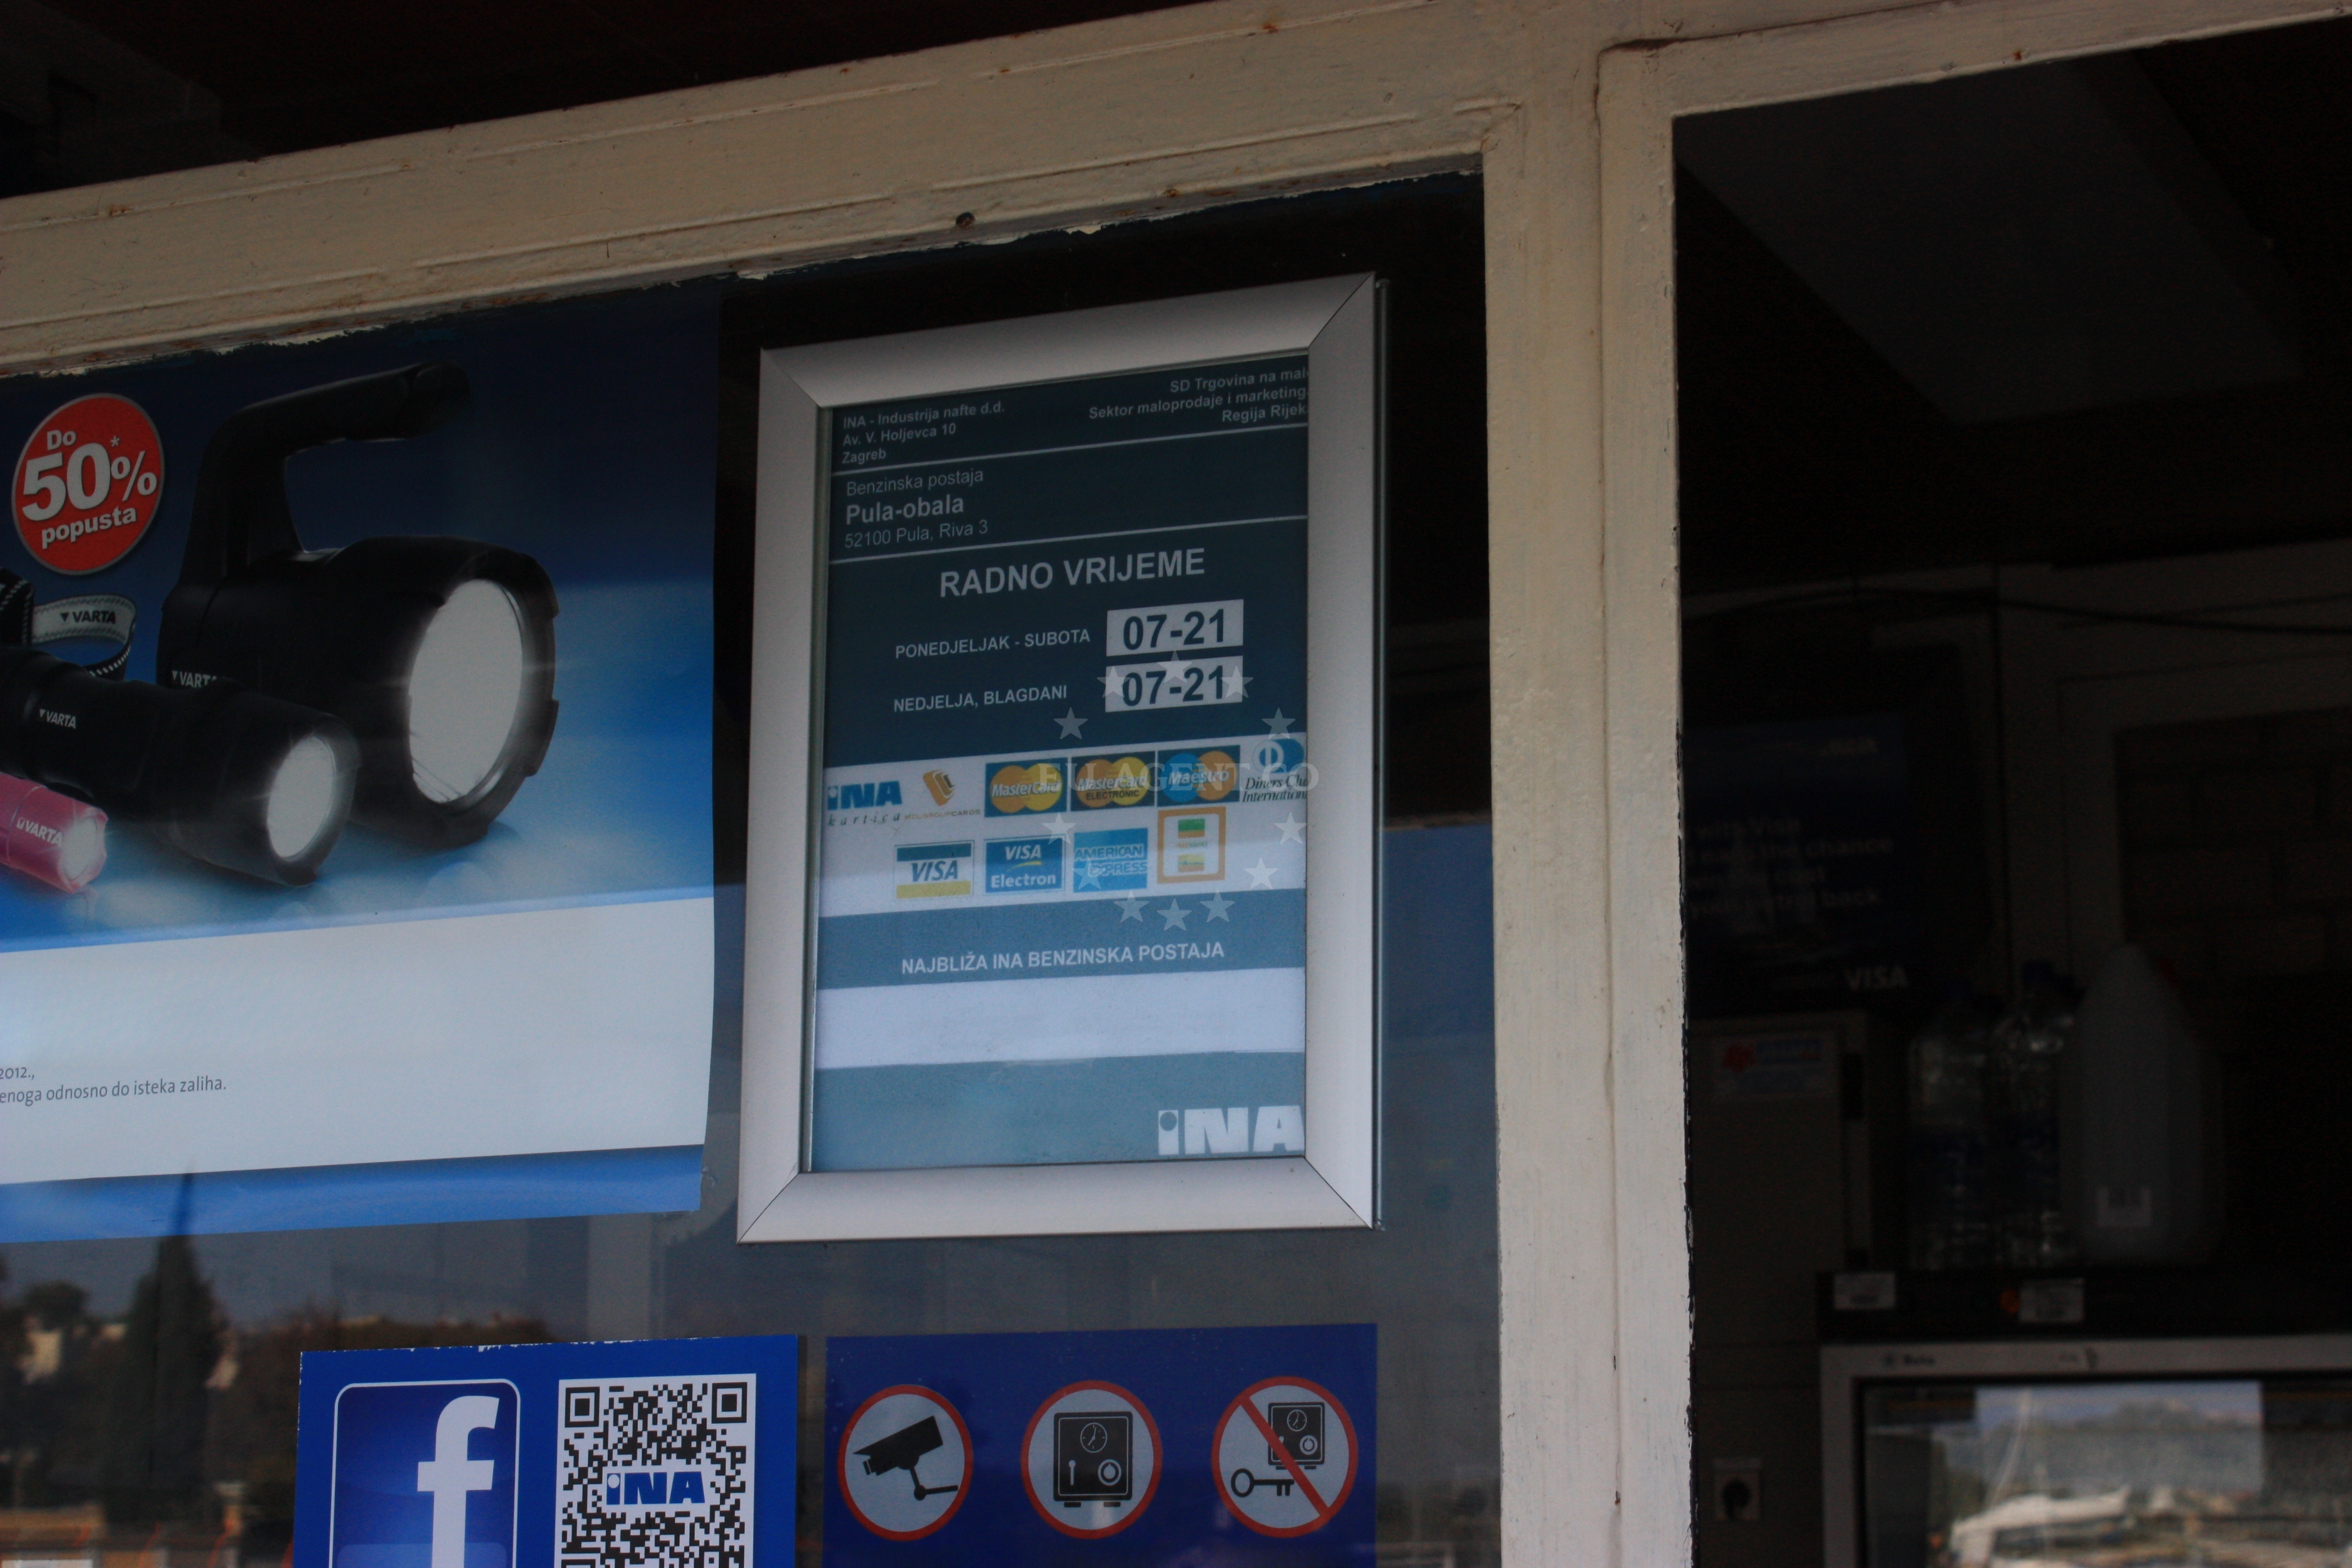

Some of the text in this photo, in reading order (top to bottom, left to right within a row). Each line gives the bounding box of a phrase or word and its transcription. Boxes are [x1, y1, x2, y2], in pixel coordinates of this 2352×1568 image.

[1169, 379, 1190, 393] SD
[1194, 374, 1255, 392] Trgovina
[1259, 371, 1276, 384] na
[1088, 386, 1308, 420] Sektor maloprodaje i marketing
[1222, 402, 1308, 424] Regija Rijek
[843, 415, 867, 429] INA
[878, 409, 939, 425] Industrija
[943, 404, 977, 418] nafte
[980, 400, 1005, 414] d.d.
[46, 429, 77, 451] Do
[842, 422, 957, 447] Av. V. Holjevca 10
[841, 448, 887, 466] Zagreb
[847, 469, 984, 496] Benzinska postaja
[845, 494, 965, 525] Pula-obala
[42, 506, 137, 549] popusta
[845, 519, 988, 548] 52100 Pula, Riva 3
[939, 548, 1206, 598] RADNO VRIJEME
[73, 610, 117, 625] VARTA
[895, 635, 1010, 659] PONEDJELJAK
[1024, 628, 1091, 649] SUBOTA
[1123, 608, 1225, 651] 07-21
[893, 665, 1224, 714] NEDJELJA, BLAGDANI 07-21
[46, 710, 77, 729] VARTA
[1078, 772, 1148, 791] MasterCard
[1168, 771, 1230, 785] Maestro
[1245, 774, 1308, 790] Diners Clu
[991, 781, 1061, 798] MasterCard
[1086, 790, 1140, 801] ELECTRONIC
[25, 819, 62, 845] VARTA
[1005, 843, 1042, 861] VISA
[1074, 845, 1143, 859] AMERICAN
[1804, 837, 1894, 859] chance
[911, 859, 959, 882] VISA
[990, 873, 1057, 889] Electron
[1820, 887, 1883, 908] back
[901, 941, 1226, 974] NAJBLIŽA INA BENZINSKA POSTAJA
[1843, 965, 1909, 991] VISA
[46, 1084, 108, 1101] odnosno
[112, 1081, 130, 1097] do
[134, 1078, 176, 1096] isteka
[179, 1075, 227, 1093] zaliha.
